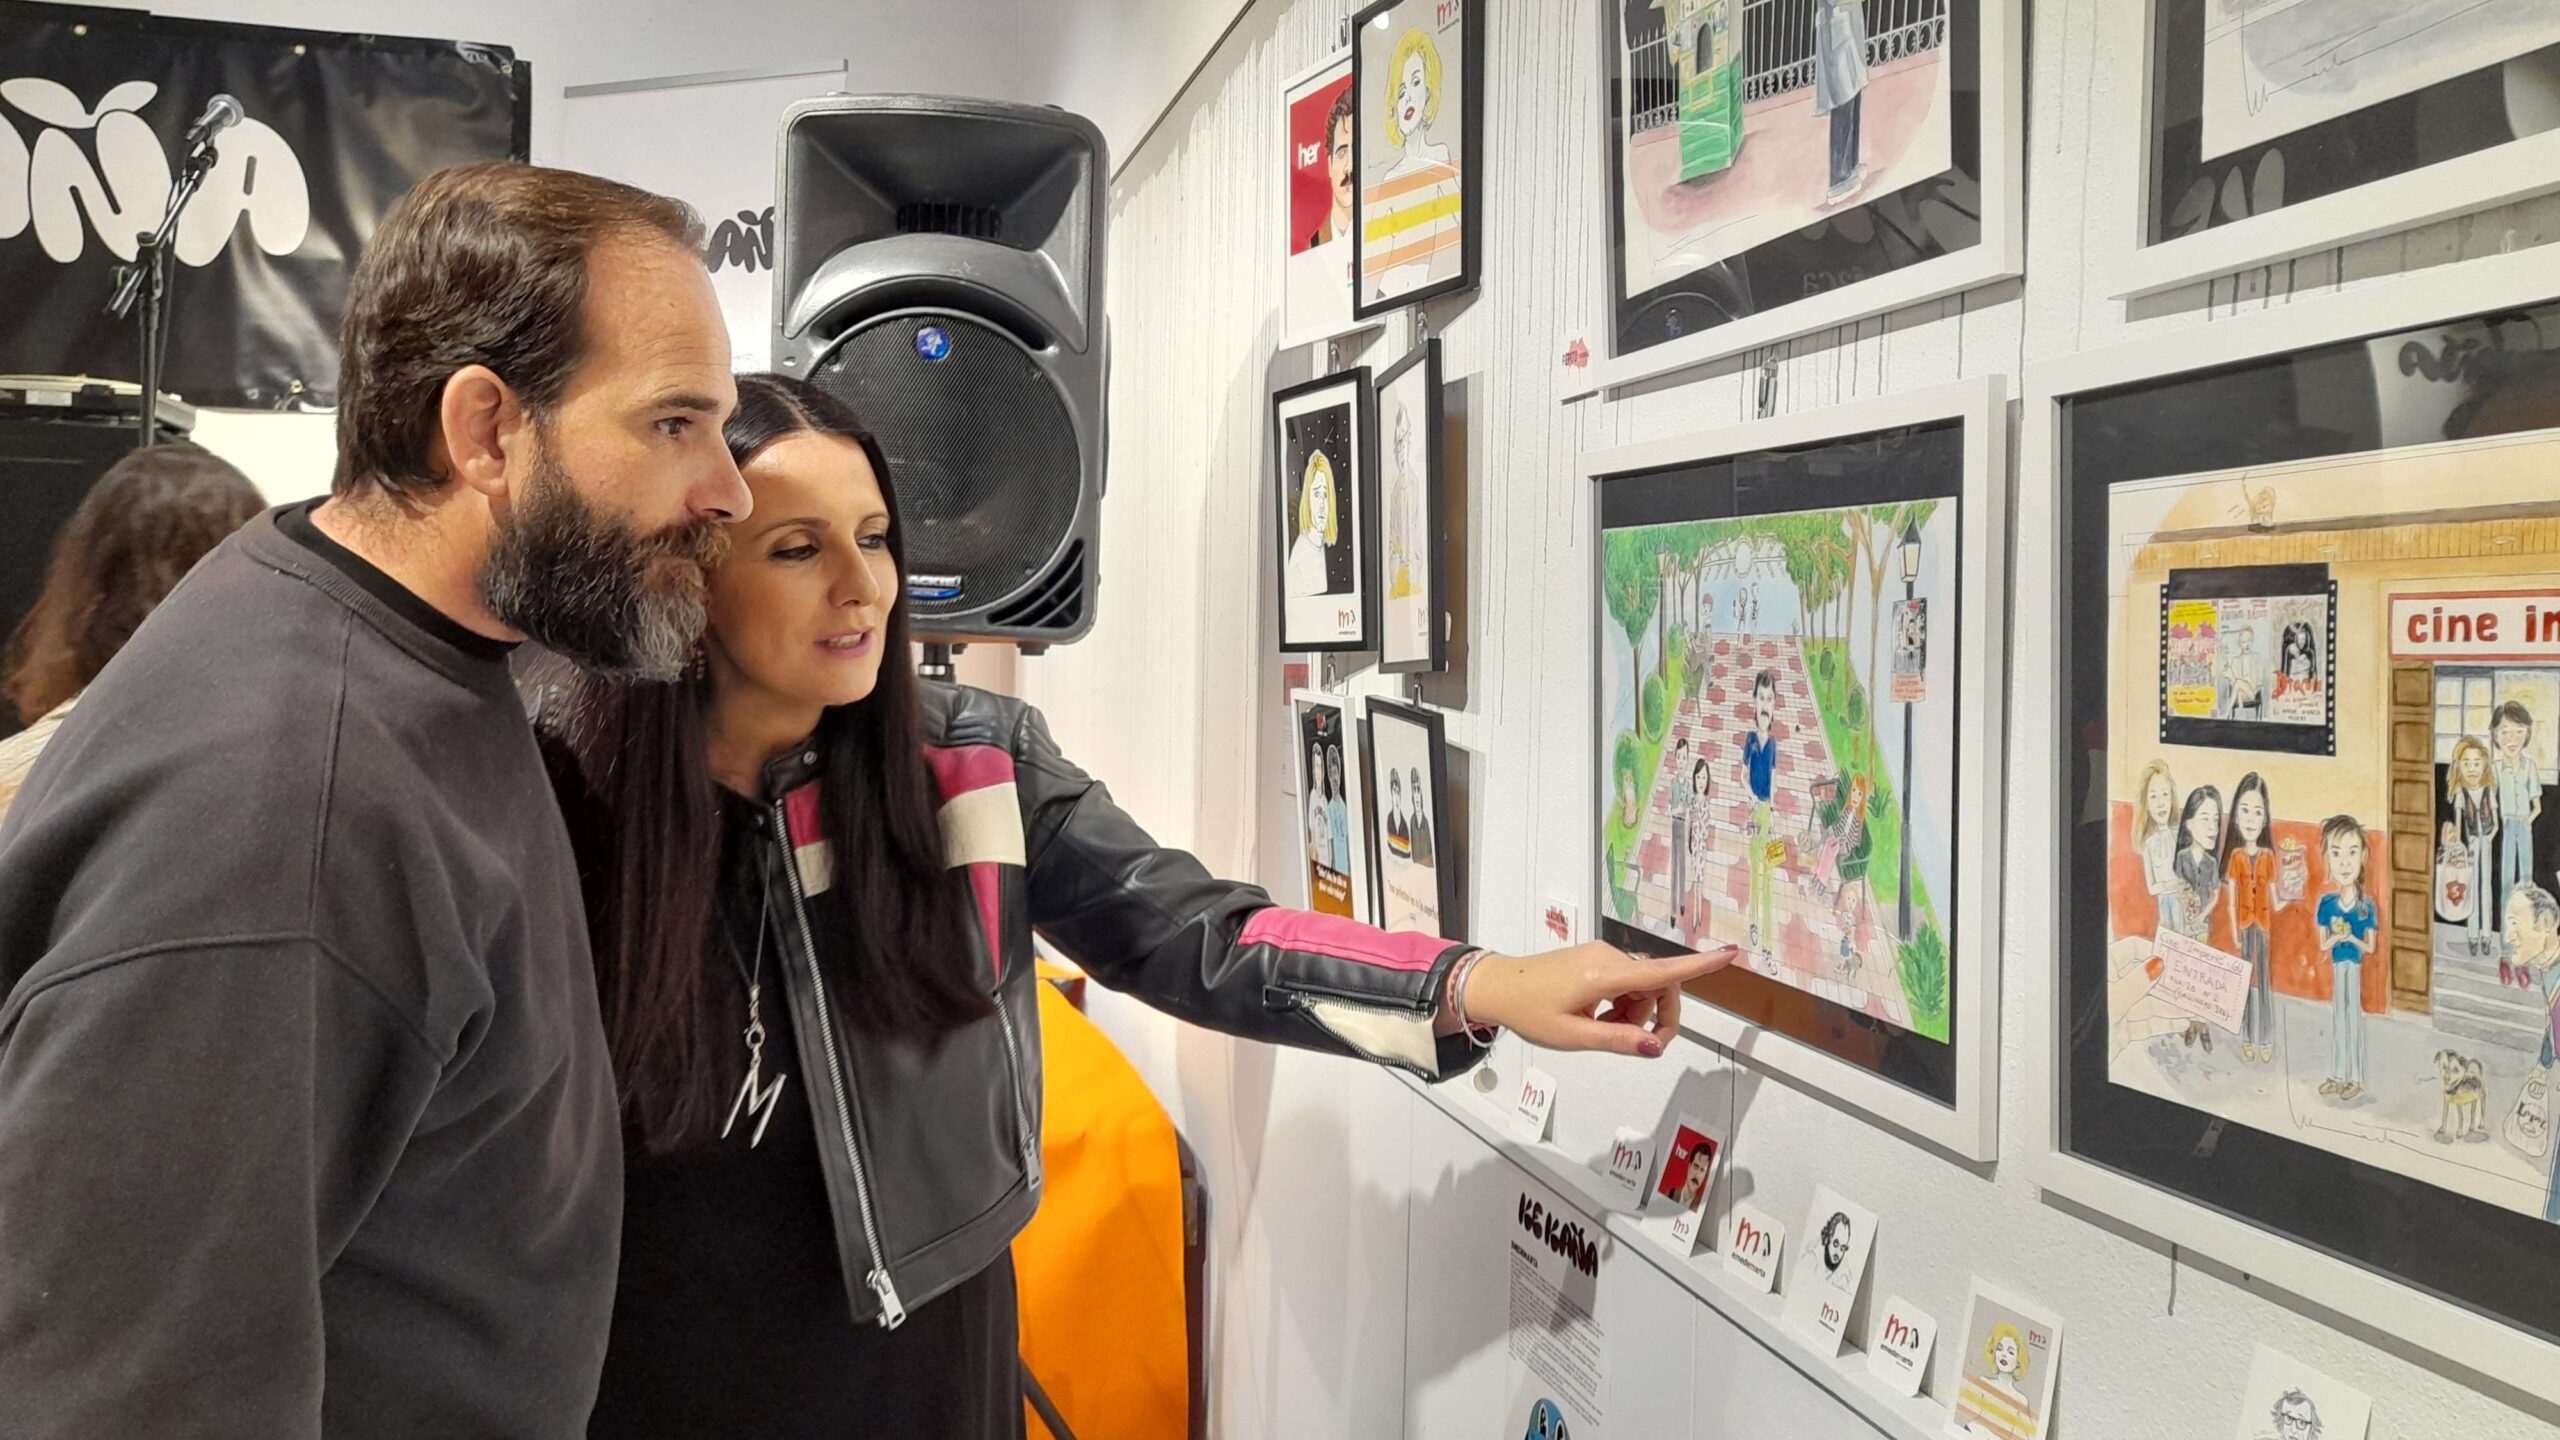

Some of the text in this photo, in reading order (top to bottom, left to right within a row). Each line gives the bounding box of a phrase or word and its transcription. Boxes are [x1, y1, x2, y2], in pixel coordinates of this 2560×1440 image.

[1298, 141, 1321, 170] her
[2408, 606, 2498, 643] cine
[1676, 1144, 1688, 1161] her
[1731, 1252, 1766, 1278] emedemarta
